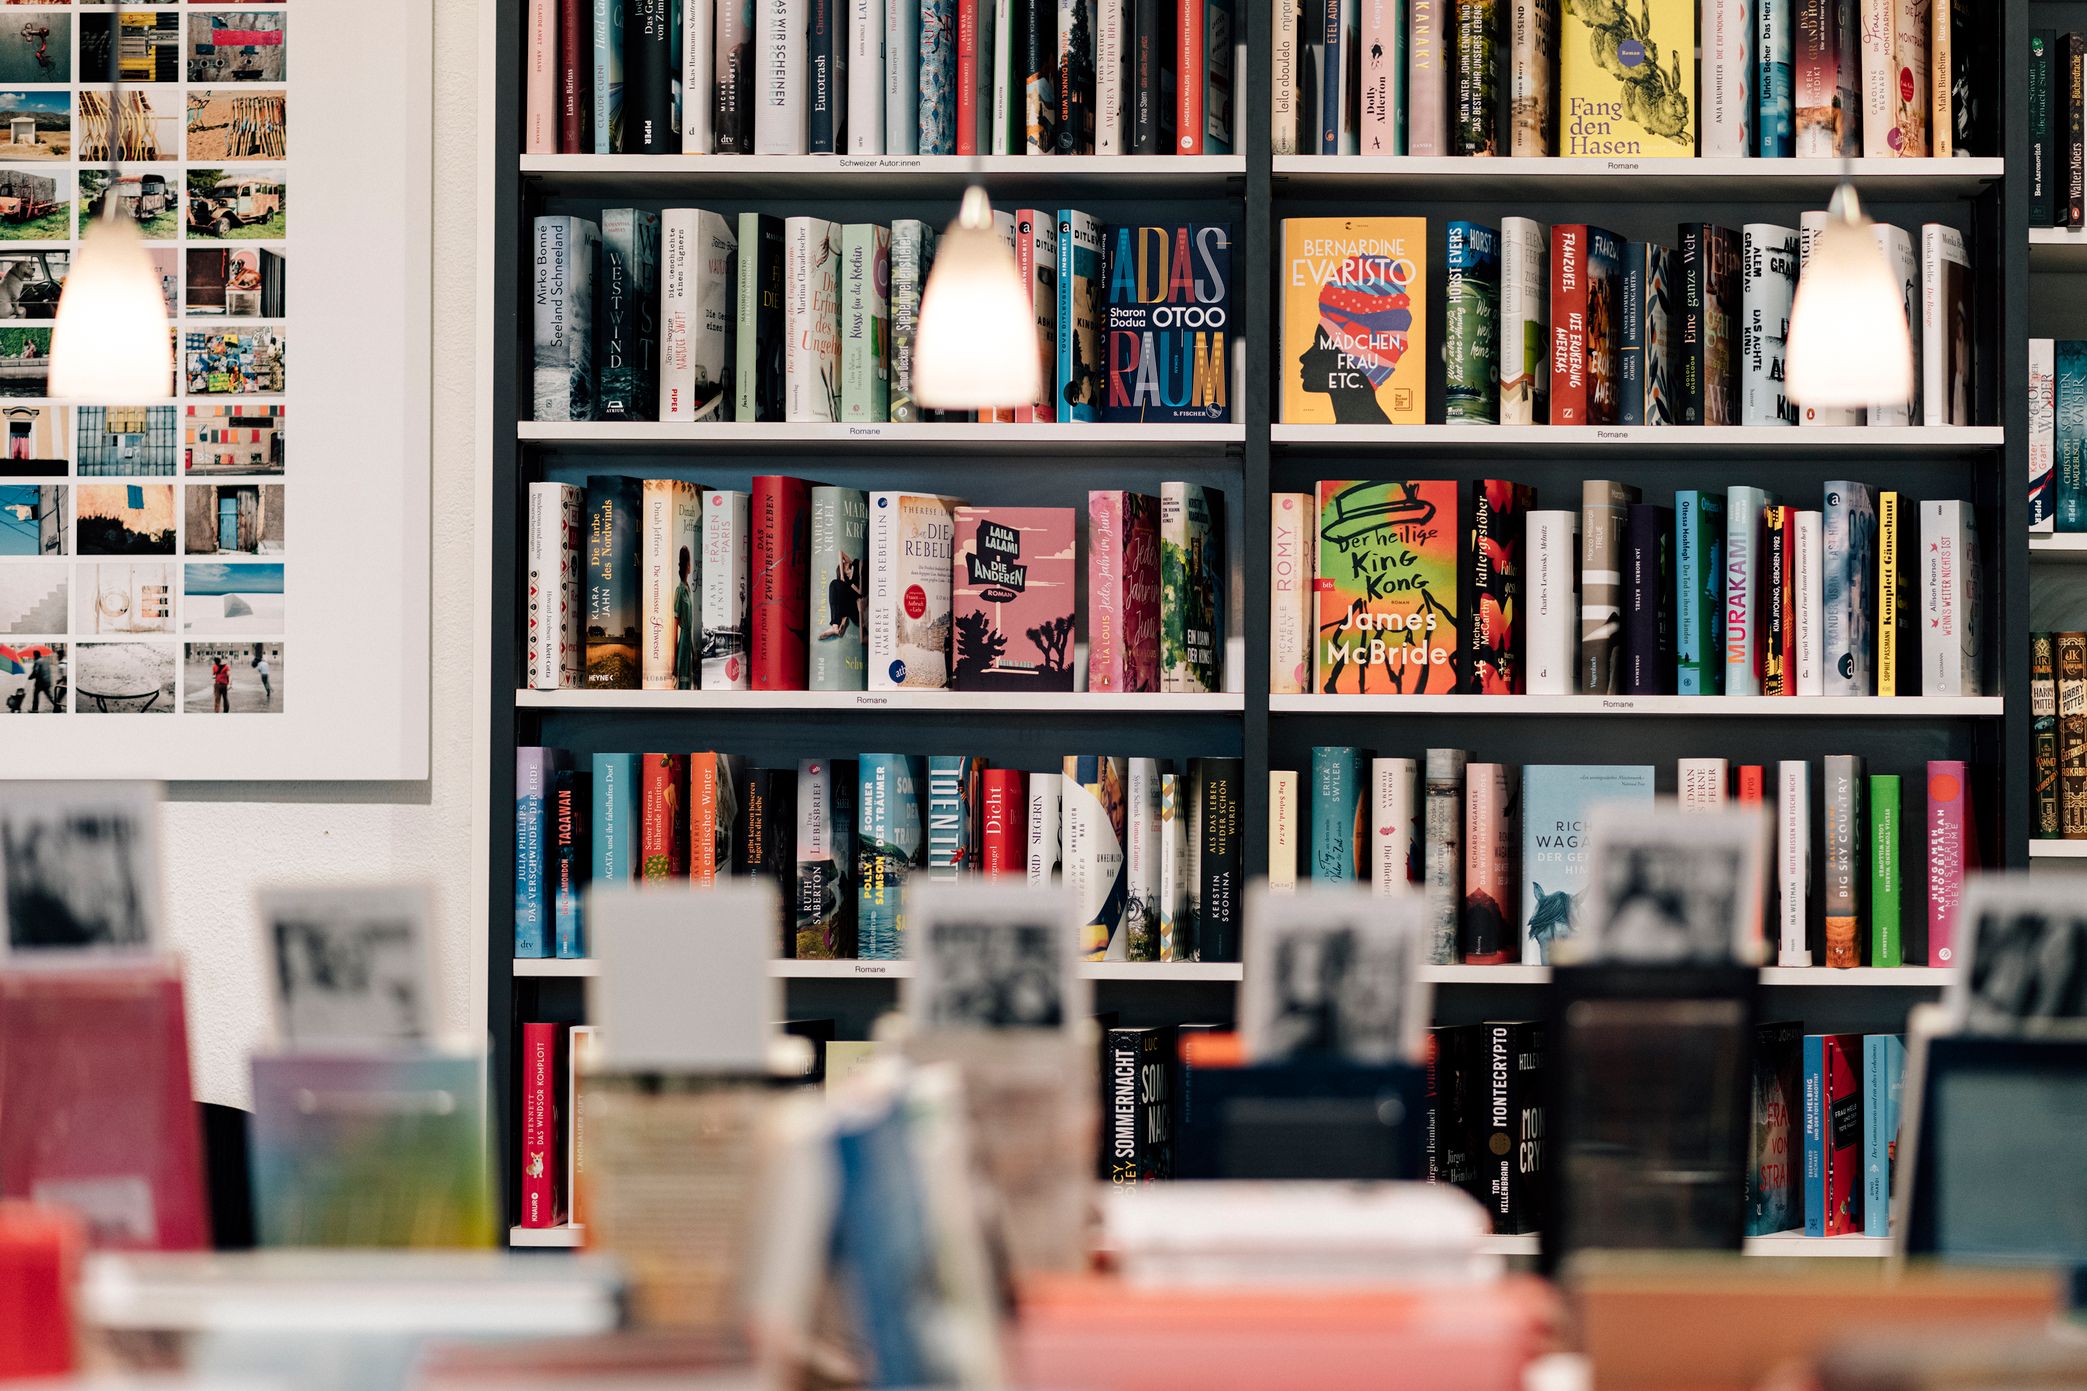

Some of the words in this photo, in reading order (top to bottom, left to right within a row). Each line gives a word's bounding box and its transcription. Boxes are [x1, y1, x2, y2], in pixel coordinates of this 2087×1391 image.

[1460, 4, 1470, 22] UND
[1473, 4, 1482, 34] LEBENS
[1763, 1, 1772, 22] Herz
[1415, 0, 1429, 71] KANAKY
[1460, 24, 1470, 50] LENNON
[1763, 23, 1772, 40] Das
[1276, 41, 1290, 87] aboulela
[1460, 51, 1470, 71] JOHN
[1473, 35, 1482, 69] UNSERES
[1763, 43, 1772, 72] Becher
[777, 45, 785, 107] SCHEINEN
[815, 55, 826, 112] Eurotrash
[1473, 70, 1482, 91] JAHR
[1763, 73, 1772, 100] Ulrich
[1276, 90, 1289, 113] leila
[1366, 85, 1376, 115] Dolly
[1376, 76, 1386, 124] Alderton
[1473, 92, 1482, 115] BESTE
[1570, 97, 1624, 121] Fang
[644, 120, 652, 145] PIPER
[1473, 116, 1482, 133] DAS
[1570, 115, 1612, 135] den
[1570, 136, 1641, 154] Hasen
[2070, 141, 2081, 167] Moers
[840, 159, 877, 168] Schweizer
[879, 159, 921, 167] Autor:innen
[1608, 162, 1639, 170] Romane
[2070, 169, 2081, 200] Walter
[537, 225, 547, 264] Bonné
[1303, 239, 1405, 257] BERNARDINE
[1449, 227, 1463, 263] EVERS
[1684, 233, 1696, 264] Welt
[550, 225, 564, 296] Schneeland
[1110, 227, 1228, 304] ADAS
[1292, 258, 1416, 287] EVARISTO
[1562, 233, 1576, 293] FRANZOBEL
[1744, 232, 1752, 294] GRABOVAC
[1753, 246, 1762, 278] ALEM
[537, 267, 547, 305] Mirko
[895, 235, 912, 332] Siebenmeilenstiefel
[1449, 265, 1463, 304] HORST
[1686, 269, 1700, 308] ganze
[550, 299, 564, 348] Seeland
[609, 252, 624, 370] WESTWIND
[1110, 307, 1146, 317] Sharon
[1110, 317, 1146, 328] Dodua
[1152, 306, 1226, 328] OTOO
[1569, 312, 1582, 330] DIE
[1753, 309, 1762, 333] DAS
[1319, 331, 1404, 351] MÄDCHEN,
[1684, 313, 1696, 345] Eine
[1744, 326, 1752, 356] KIND
[1110, 331, 1226, 408] RAUM
[1337, 353, 1379, 370] FRAU
[1753, 337, 1762, 373] ACHTE
[1328, 372, 1364, 389] ETC.
[671, 388, 679, 413] PIPER
[1597, 431, 1629, 439] Romane
[2034, 499, 2042, 524] PIPER
[591, 513, 600, 544] Farbe
[603, 498, 612, 557] Nordwinds
[990, 525, 1014, 542] LAILA
[1336, 535, 1370, 553] Der
[1375, 525, 1439, 549] heilige
[1476, 495, 1490, 588] Faltergestöber
[1883, 499, 1892, 565] Gänsehaut
[591, 549, 600, 567] Die
[985, 536, 1018, 555] LALAMI
[1277, 525, 1292, 592] ROMY
[603, 563, 612, 580] des
[974, 558, 1024, 586] ANDEREN
[991, 560, 1008, 572] DIE
[1352, 550, 1418, 580] King
[1365, 572, 1430, 602] Kong
[1728, 531, 1747, 665] MURAKAMI
[591, 586, 600, 621] KLARA
[602, 588, 611, 618] JAHN
[1339, 605, 1437, 631] James
[1883, 581, 1892, 626] Komplett
[1473, 613, 1482, 650] Michael
[1481, 598, 1492, 645] McCarthy
[1327, 640, 1448, 665] McBride
[588, 674, 609, 682] HEYNE
[2062, 684, 2084, 701] HARRY
[856, 696, 887, 705] Romane
[1603, 700, 1634, 708] Romane
[2062, 696, 2085, 712] POTTER
[529, 763, 538, 795] ERDE
[701, 768, 713, 808] Winter
[875, 765, 885, 823] TRÄUMER
[1323, 768, 1331, 796] ERIKA
[1332, 762, 1341, 802] SWYLER
[529, 797, 538, 824] DER
[864, 781, 873, 832] SOMMER
[986, 786, 1002, 835] Dicht
[1209, 781, 1217, 813] LEBEN
[519, 804, 527, 851] PHILLIPS
[559, 790, 572, 847] TAQAWAN
[811, 782, 821, 855] LIEBESBRIEF
[1033, 795, 1042, 845] SIEGERIN
[1209, 815, 1217, 835] DAS
[701, 809, 713, 867] englischer
[875, 825, 885, 847] DER
[1209, 839, 1217, 854] ALS
[1219, 823, 1227, 856] WIEDER
[519, 854, 527, 882] JULIA
[529, 827, 538, 900] VERSCHWINDEN
[1838, 845, 1848, 872] SKY
[1931, 829, 1939, 900] HENGAMEH
[813, 865, 822, 925] SABERTON
[864, 860, 873, 900] POLLY
[875, 855, 885, 905] SAMSON
[1838, 871, 1848, 898] BIG
[804, 880, 813, 914] RUTH
[1212, 874, 1220, 918] KERSTIN
[1222, 871, 1230, 922] SGONINA
[529, 903, 538, 923] DAS
[520, 939, 534, 950] dtv
[855, 966, 886, 974] Romane
[536, 1042, 545, 1086] KOMPLOTT
[1492, 1027, 1507, 1127] MONTECRYPTO
[536, 1088, 545, 1128] WINDSOR
[1115, 1048, 1135, 1159] SOMMERNACHT
[536, 1130, 545, 1145] DAS
[1492, 1178, 1501, 1195] TOM
[1501, 1160, 1509, 1214] HILLENBRAND
[531, 1200, 539, 1222] KNAUR
